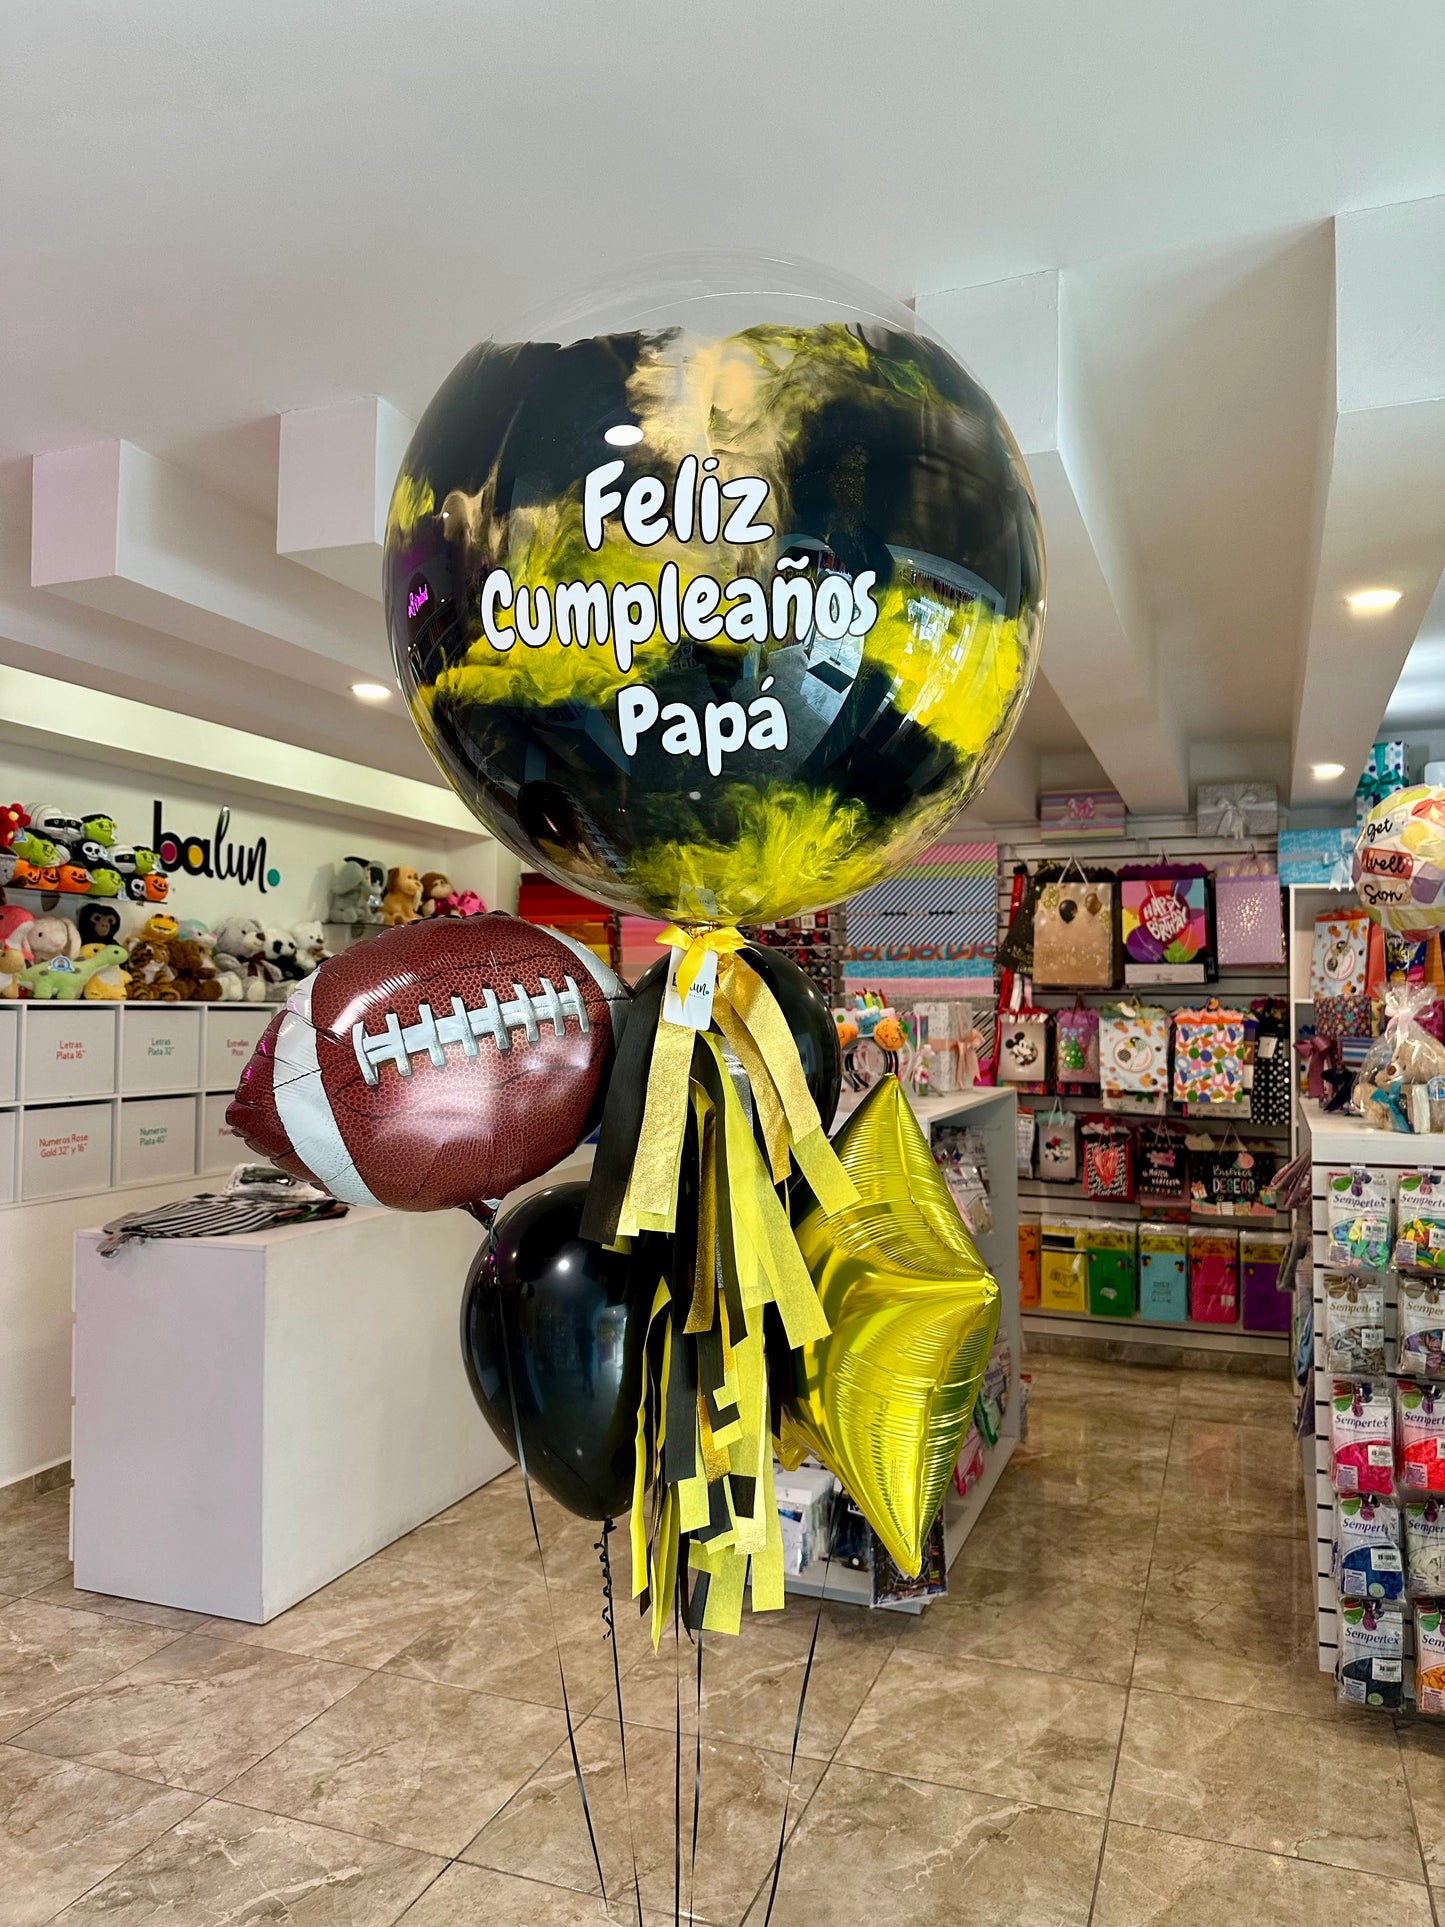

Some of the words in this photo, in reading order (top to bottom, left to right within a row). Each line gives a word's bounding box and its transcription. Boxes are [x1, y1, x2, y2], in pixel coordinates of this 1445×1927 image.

[584, 454, 775, 551] Feliz
[481, 556, 879, 673] Cumpleaños
[616, 675, 789, 777] Papá
[1366, 818, 1393, 842] get
[1143, 894, 1181, 920] HAPPY
[60, 1040, 83, 1050] Letras
[151, 1037, 171, 1047] Letras
[56, 1050, 74, 1060] Plata
[147, 1047, 164, 1056] Plata
[71, 1133, 89, 1143] Rose
[40, 1147, 57, 1159] Gold
[1333, 1194, 1386, 1209] Sempertex
[1335, 1414, 1388, 1430] Sempertex
[1345, 1626, 1400, 1645] Sempertex
